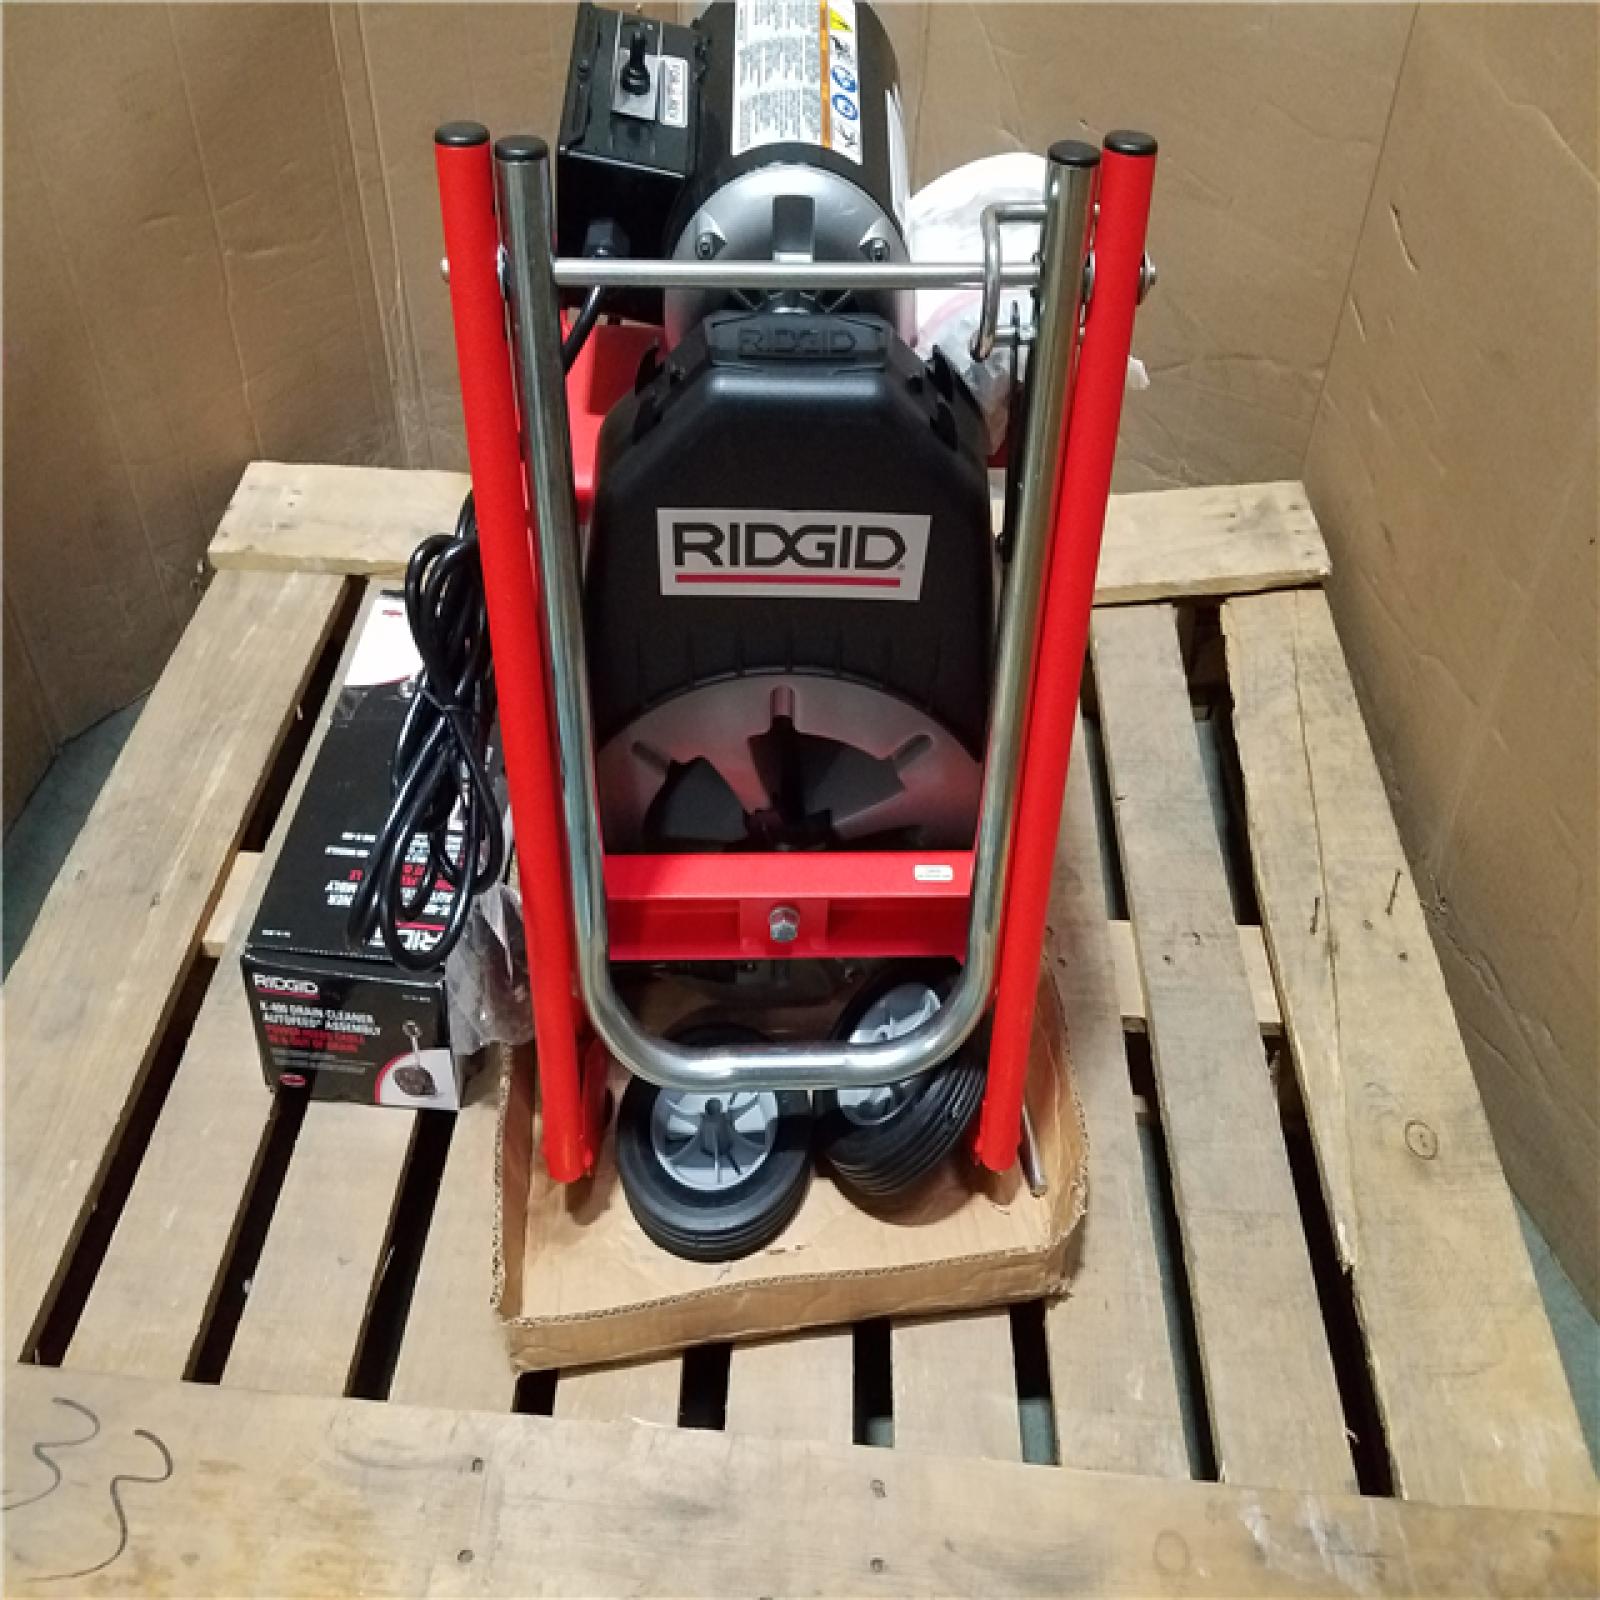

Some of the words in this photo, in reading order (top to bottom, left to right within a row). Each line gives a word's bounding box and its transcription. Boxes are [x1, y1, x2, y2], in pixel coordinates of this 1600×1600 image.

[739, 328, 857, 352] RIDGID
[672, 521, 907, 570] RIDGID
[252, 972, 319, 995] RIDGID
